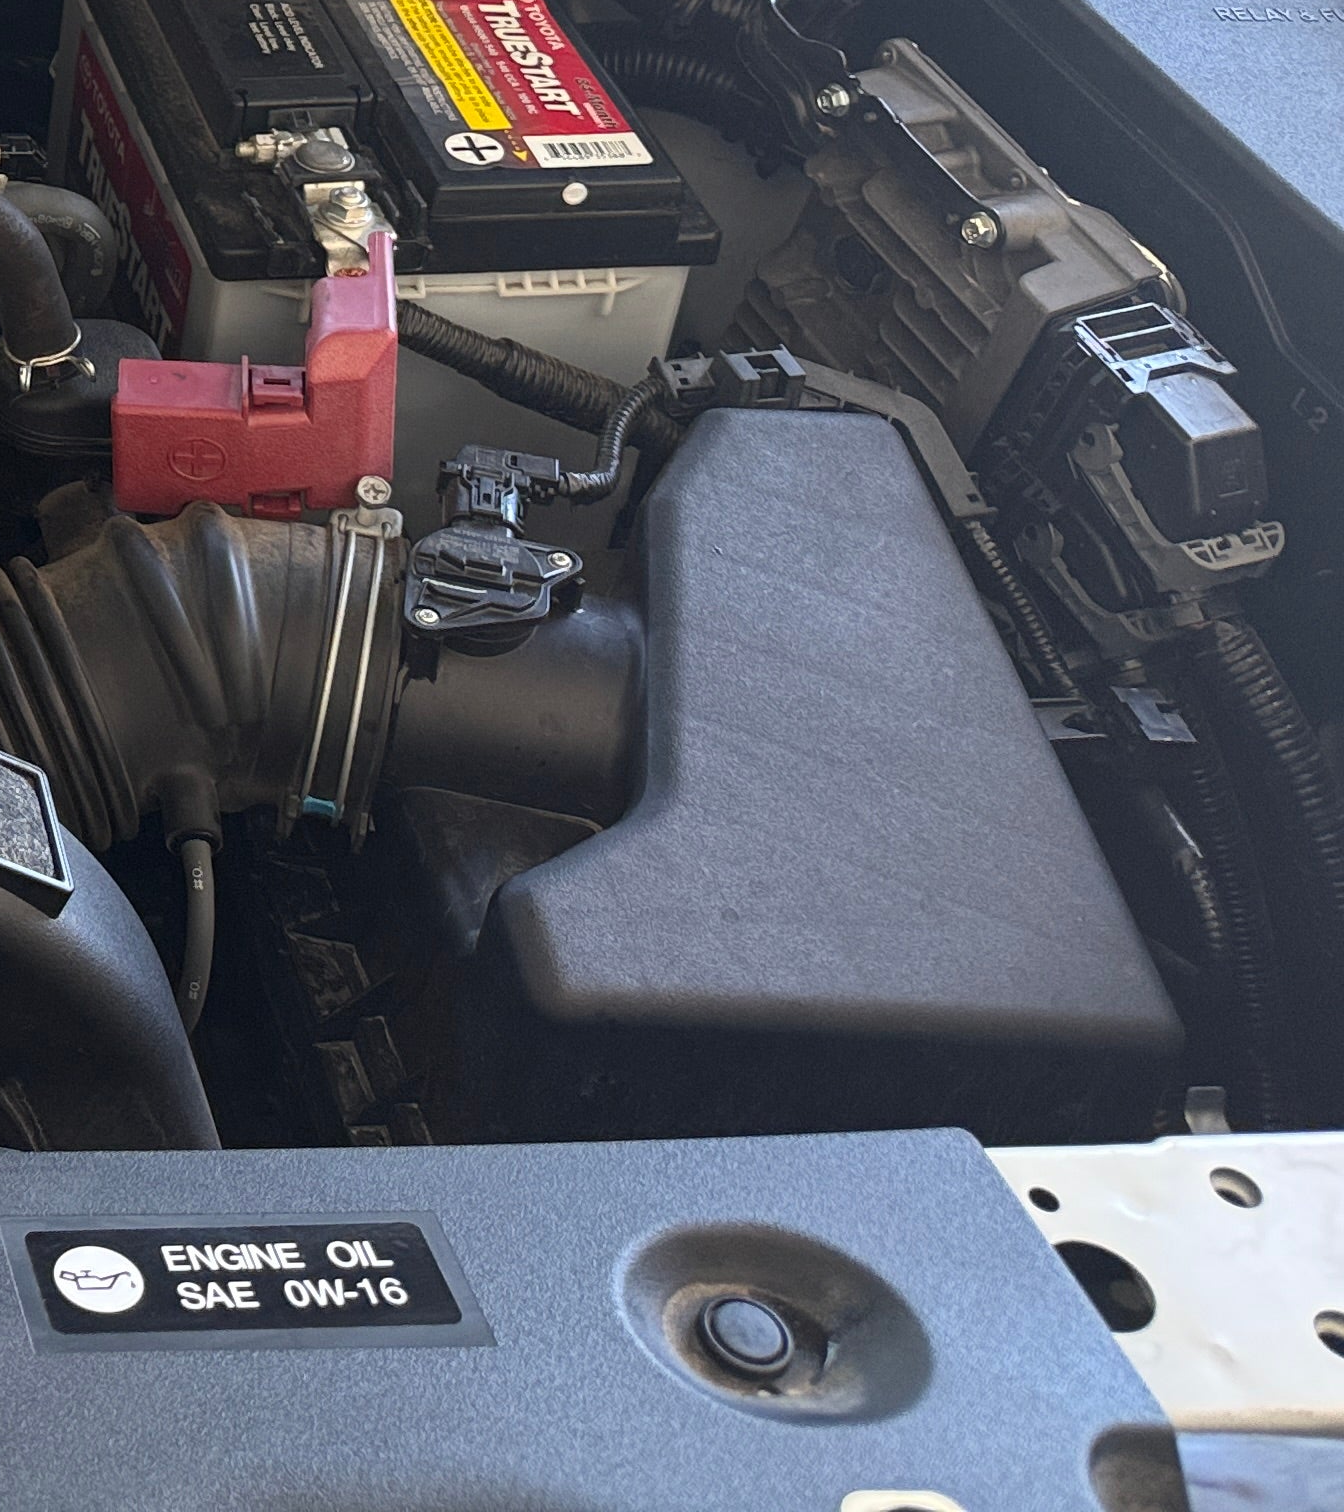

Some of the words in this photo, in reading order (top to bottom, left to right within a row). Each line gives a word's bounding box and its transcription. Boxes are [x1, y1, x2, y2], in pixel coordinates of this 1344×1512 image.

[525, 4, 565, 51] TOYOTA
[1214, 6, 1294, 23] RELAY
[1297, 8, 1319, 23] &
[288, 17, 304, 35] LEVEL
[298, 35, 323, 68] INDICATOR
[160, 1242, 307, 1272] ENGINE
[326, 1239, 395, 1268] OIL
[176, 1280, 261, 1310] SAE
[283, 1276, 409, 1308] 0W-16
